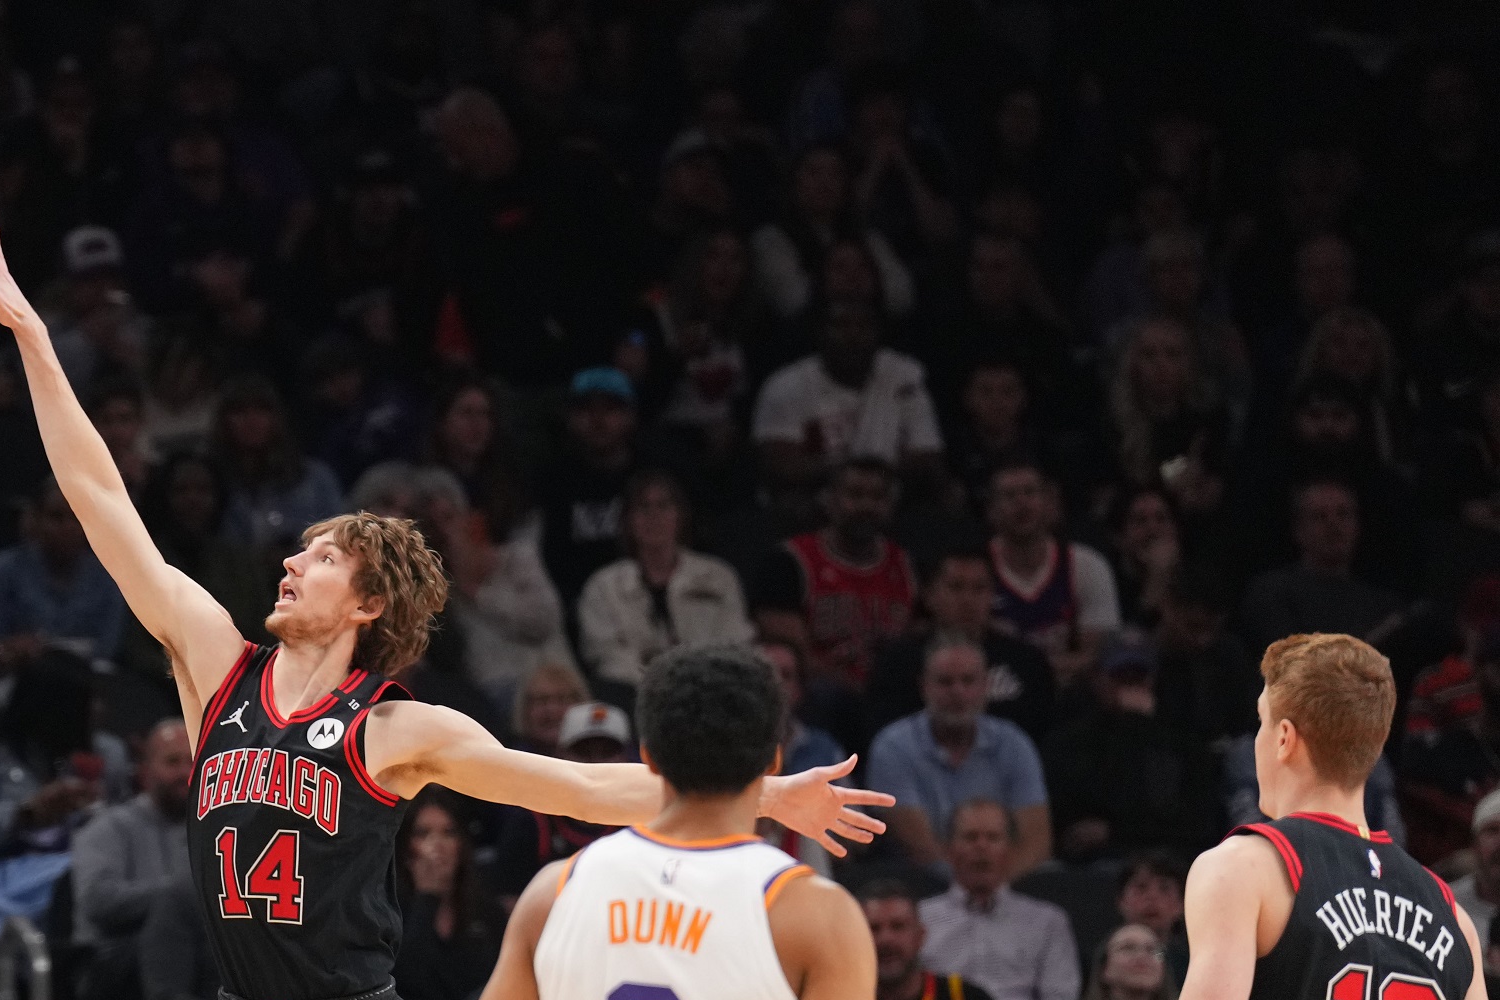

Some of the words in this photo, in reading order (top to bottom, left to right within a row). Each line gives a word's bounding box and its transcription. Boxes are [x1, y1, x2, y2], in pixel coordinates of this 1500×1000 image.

[197, 747, 342, 836] CHICAGO
[215, 826, 304, 925] 14
[609, 899, 712, 953] DUNN
[1315, 887, 1455, 971] HUERTER
